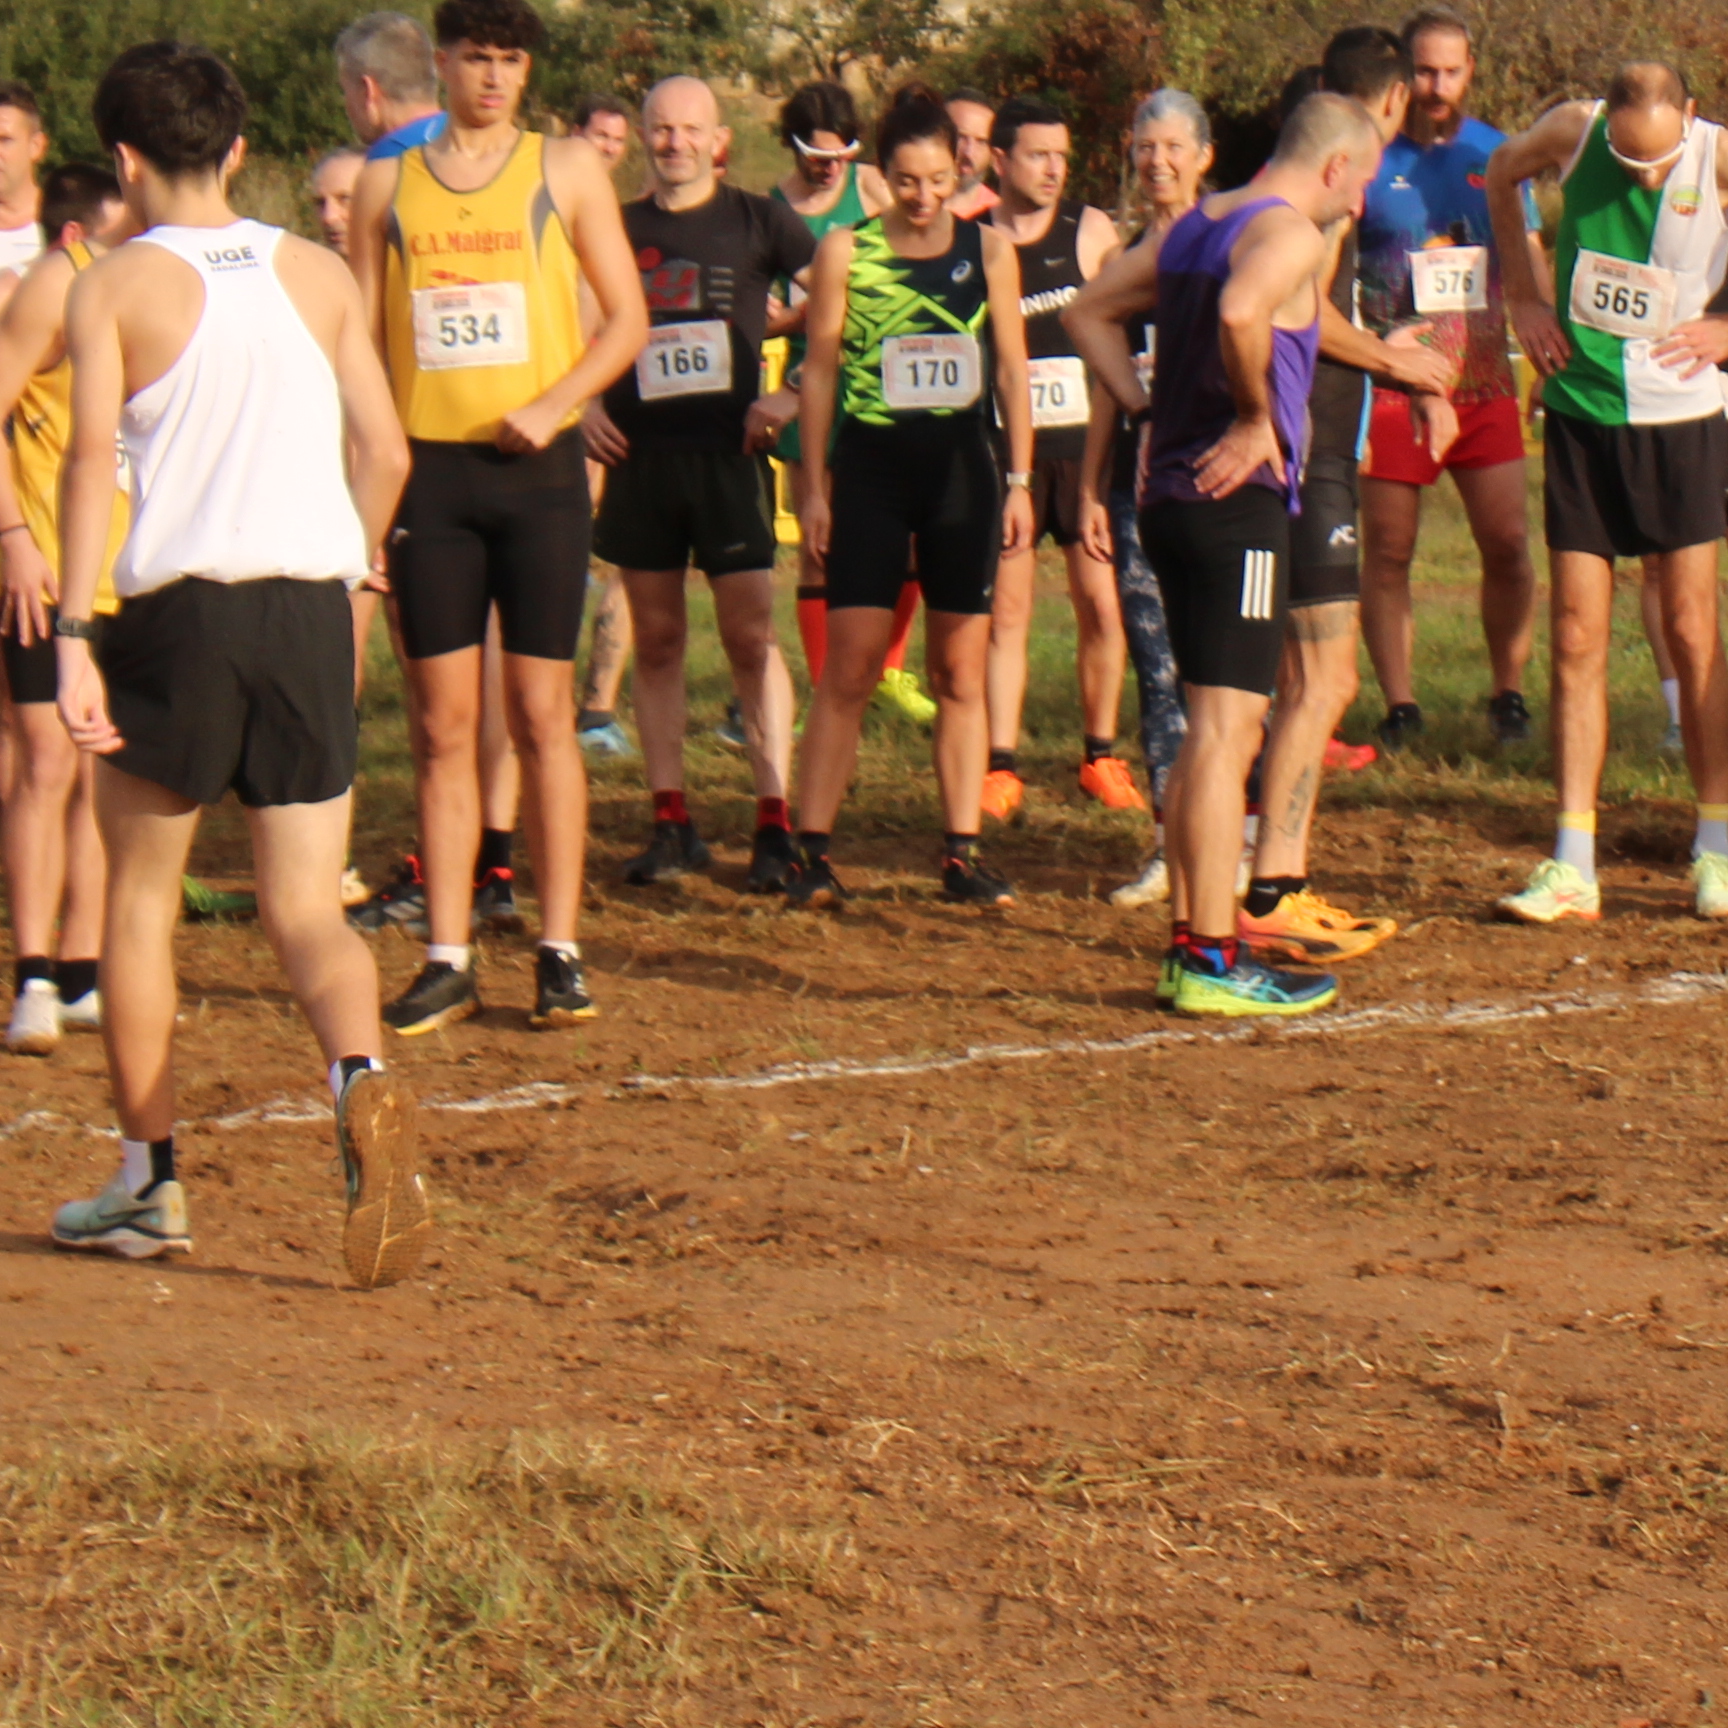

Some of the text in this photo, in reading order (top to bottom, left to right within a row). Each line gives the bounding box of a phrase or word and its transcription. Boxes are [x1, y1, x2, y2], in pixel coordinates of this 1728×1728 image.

[203, 245, 256, 265] UGE
[1434, 270, 1473, 295] 576
[1593, 281, 1650, 320] 565
[438, 313, 502, 348] 534
[655, 345, 708, 377] 166
[907, 359, 959, 388] 170
